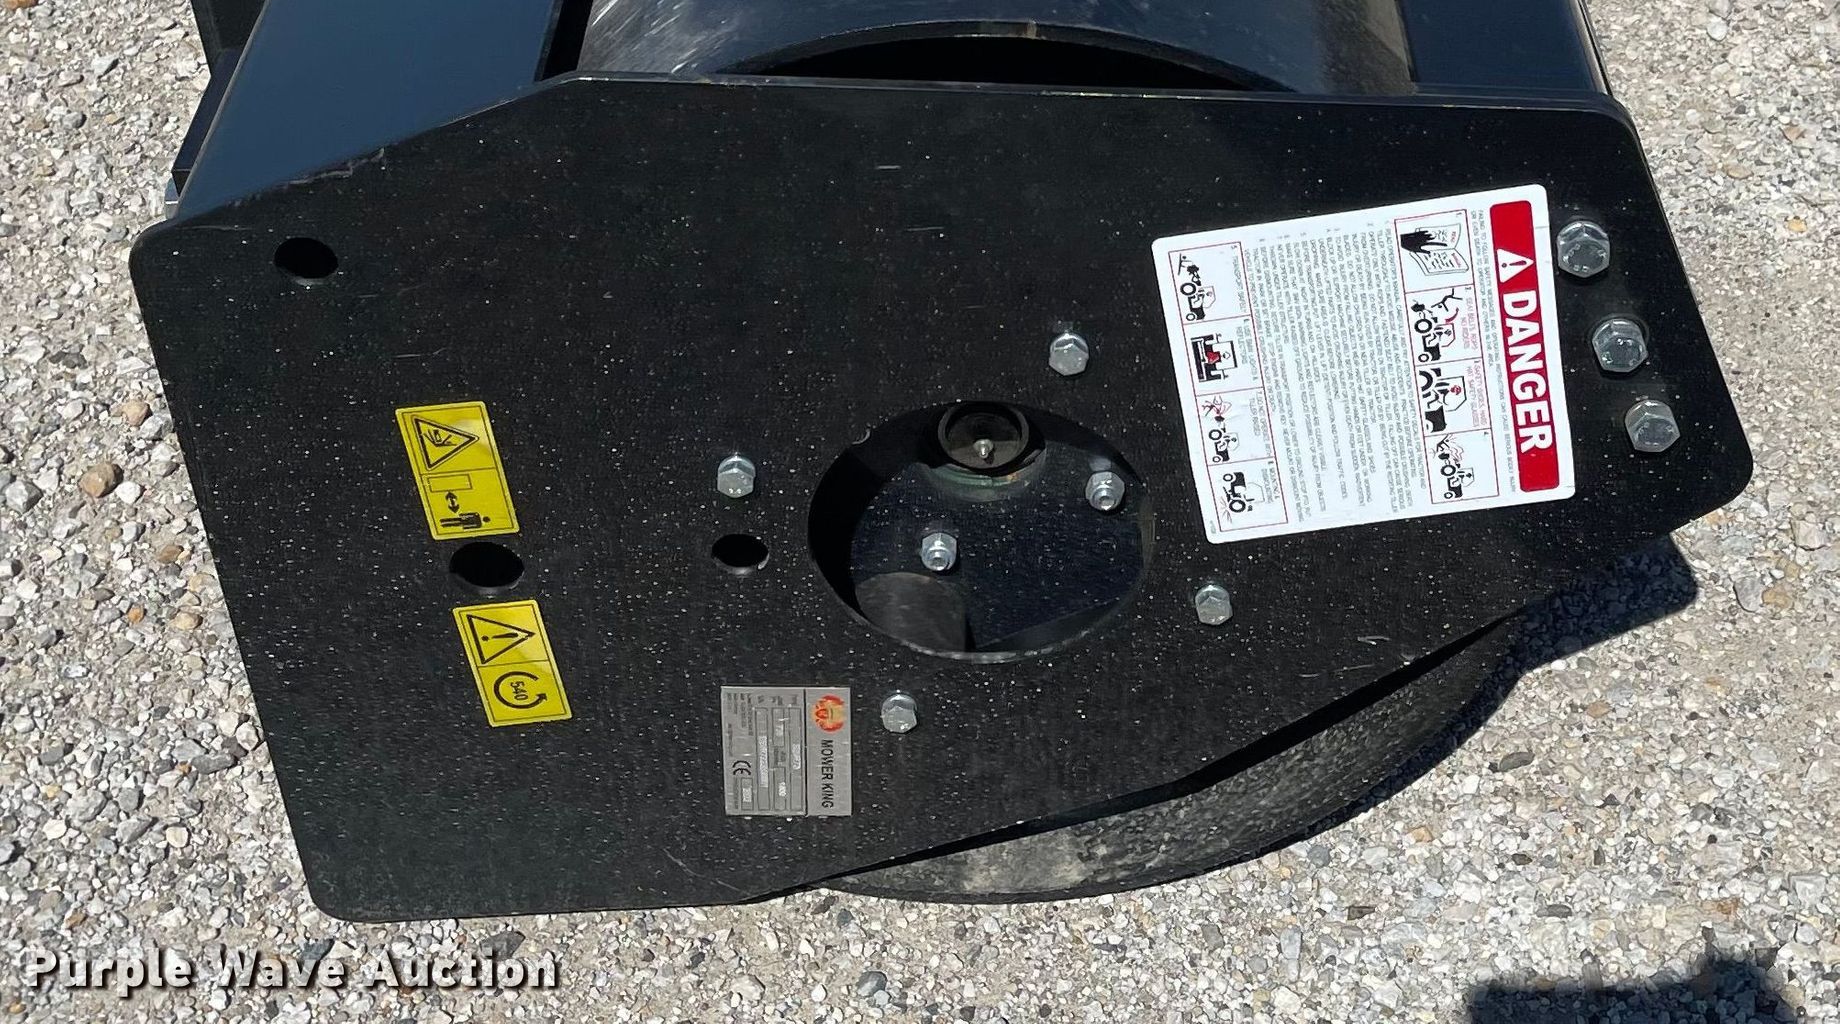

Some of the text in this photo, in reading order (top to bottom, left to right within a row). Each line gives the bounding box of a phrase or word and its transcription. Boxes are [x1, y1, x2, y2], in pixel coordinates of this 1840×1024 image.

[1502, 289, 1553, 454] DANGER
[510, 681, 529, 701] 540
[821, 739, 835, 809] MOWER KING
